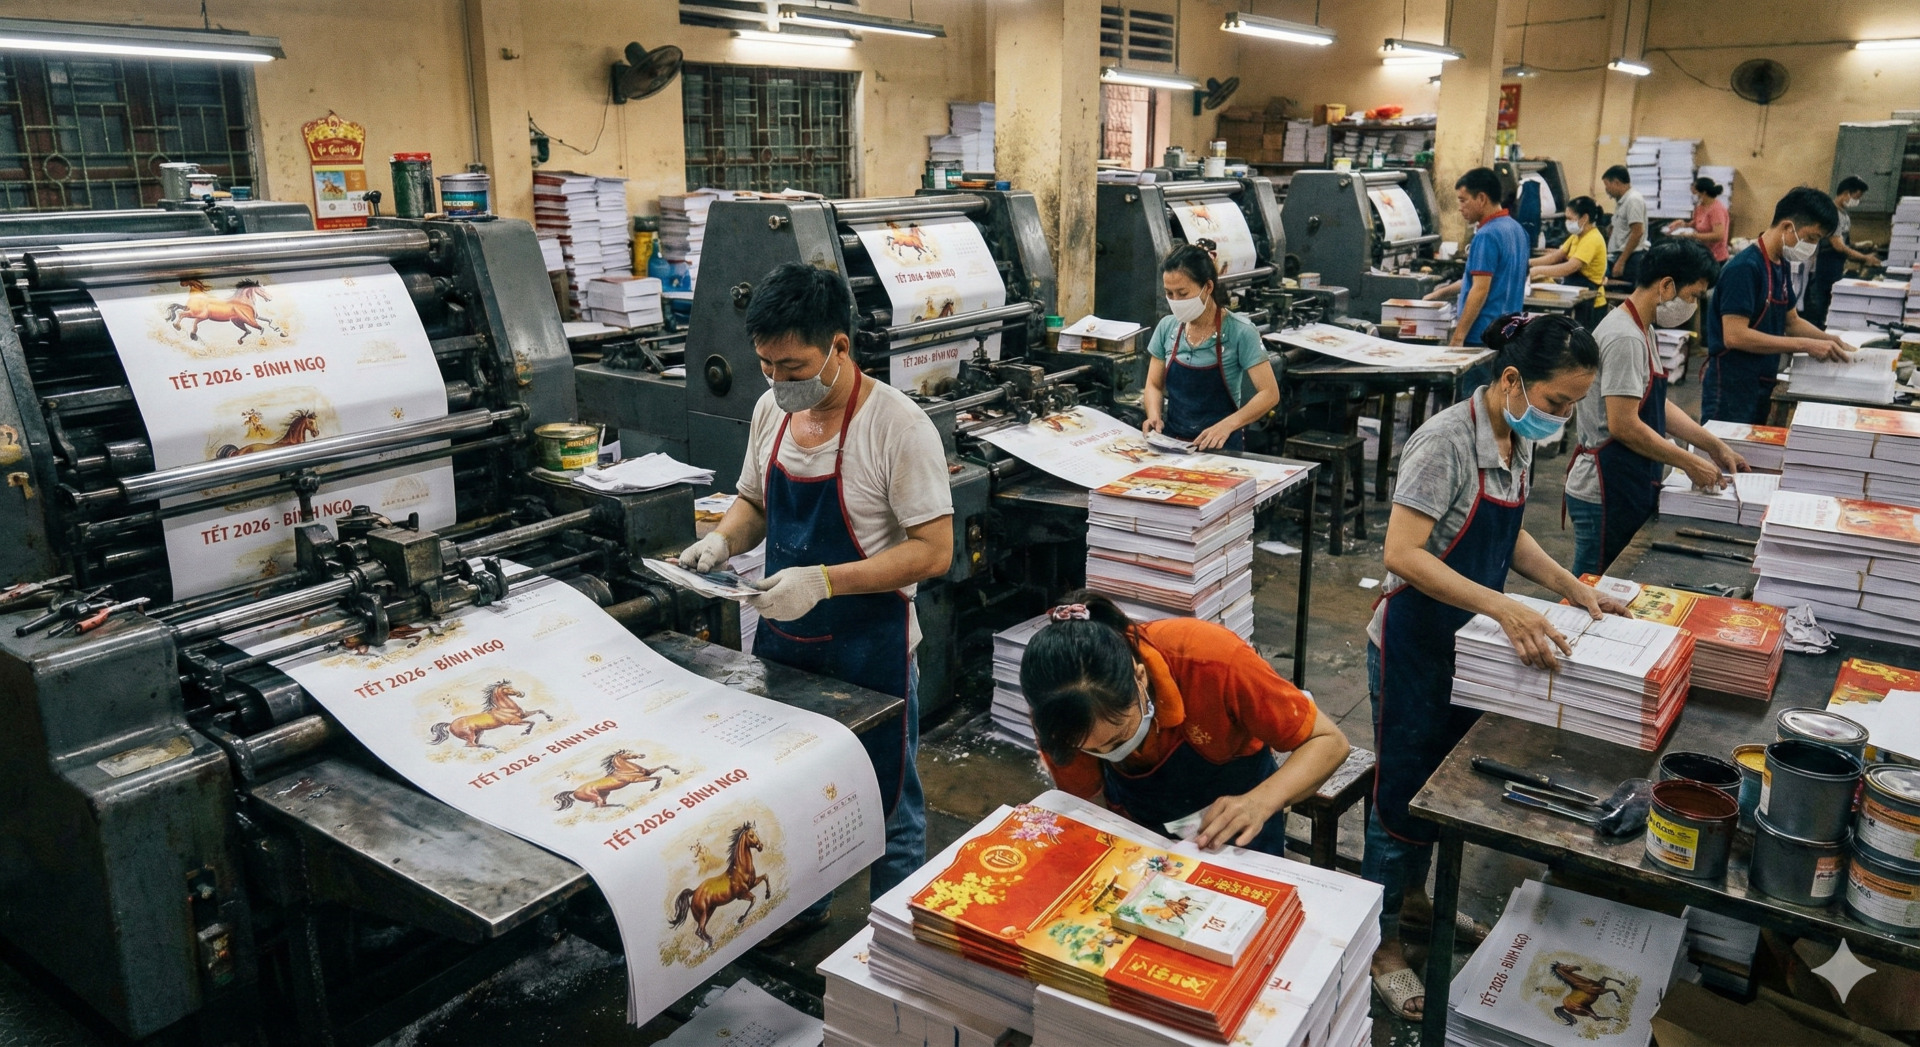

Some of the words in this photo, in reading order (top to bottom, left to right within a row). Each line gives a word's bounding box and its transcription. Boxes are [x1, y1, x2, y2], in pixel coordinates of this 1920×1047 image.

[169, 370, 199, 390] TẾT
[203, 368, 243, 386] 2026
[253, 361, 292, 379] BÍNH
[293, 356, 326, 373] NGỌ
[201, 524, 229, 545] TẾT
[233, 518, 271, 538] 2026
[323, 499, 353, 517] NGỌ
[354, 680, 386, 699] TẾT
[385, 667, 427, 689] 2026
[433, 650, 473, 671] BÍNH
[471, 639, 505, 657] NGỌ
[499, 754, 541, 776] 2026
[545, 733, 587, 754] BÍNH
[583, 720, 619, 738] NGỌ
[603, 829, 637, 851] TẾT
[634, 808, 676, 835] 2026
[679, 784, 720, 809] BÍNH
[714, 768, 750, 789] NGỌ
[1489, 972, 1509, 993] 2026
[1511, 933, 1532, 951] NGỌ
